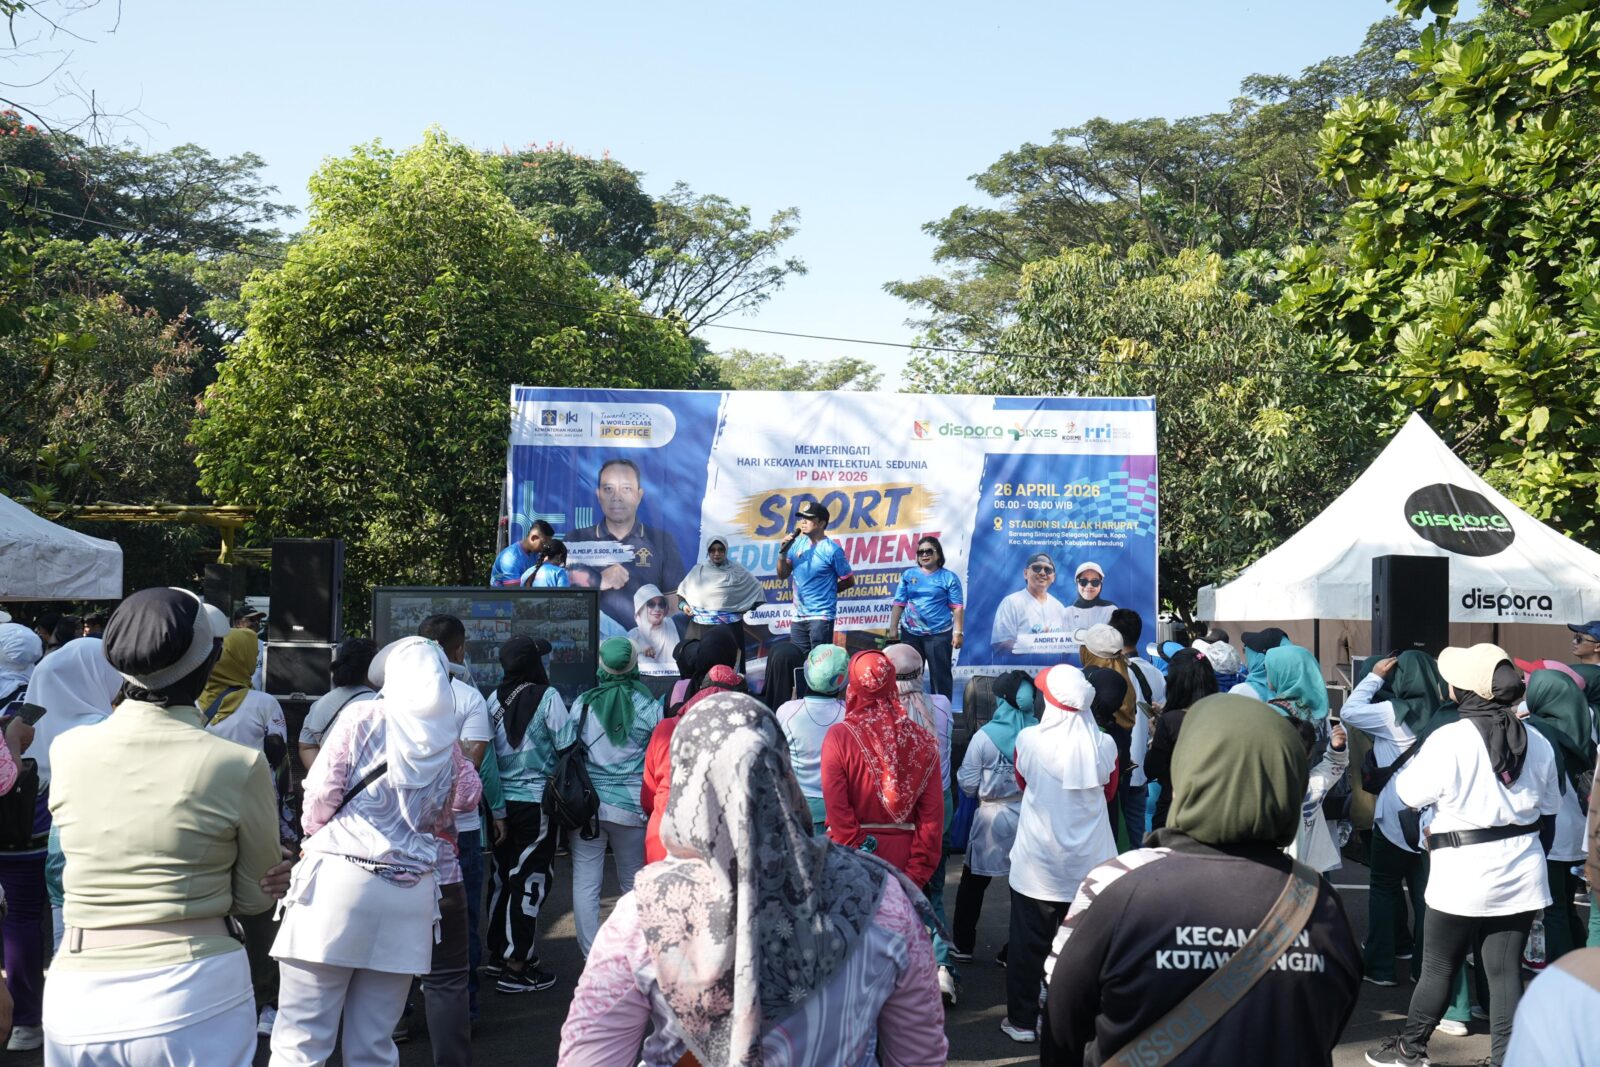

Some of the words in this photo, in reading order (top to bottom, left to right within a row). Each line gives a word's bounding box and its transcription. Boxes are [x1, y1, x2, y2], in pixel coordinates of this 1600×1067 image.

[602, 428, 611, 436] IP
[613, 428, 649, 437] OFFICE
[938, 422, 1004, 439] dispora
[1084, 423, 1111, 439] rri
[794, 445, 870, 455] MEMPERINGATI
[737, 457, 760, 467] HARI
[764, 458, 814, 468] KEKAYAAN
[818, 459, 882, 469] INTELEKTUAL
[886, 460, 928, 469] SEDUNIA
[796, 470, 807, 481] IP
[812, 470, 834, 481] DAY
[838, 471, 868, 481] 2026
[994, 483, 1012, 496] 26
[1016, 483, 1060, 497] APRIL
[1063, 484, 1100, 497] 2026
[754, 487, 913, 537] SPORT
[994, 500, 1019, 509] 06.00
[1055, 501, 1073, 510] WIB
[1008, 520, 1049, 529] STADION
[1051, 520, 1060, 529] SI
[1062, 520, 1093, 529] JALAK
[1095, 521, 1139, 530] HARUPAT
[1411, 511, 1509, 531] dispora
[1461, 588, 1552, 616] dispora
[750, 610, 781, 619] JAWARA
[838, 605, 871, 615] JAWARA
